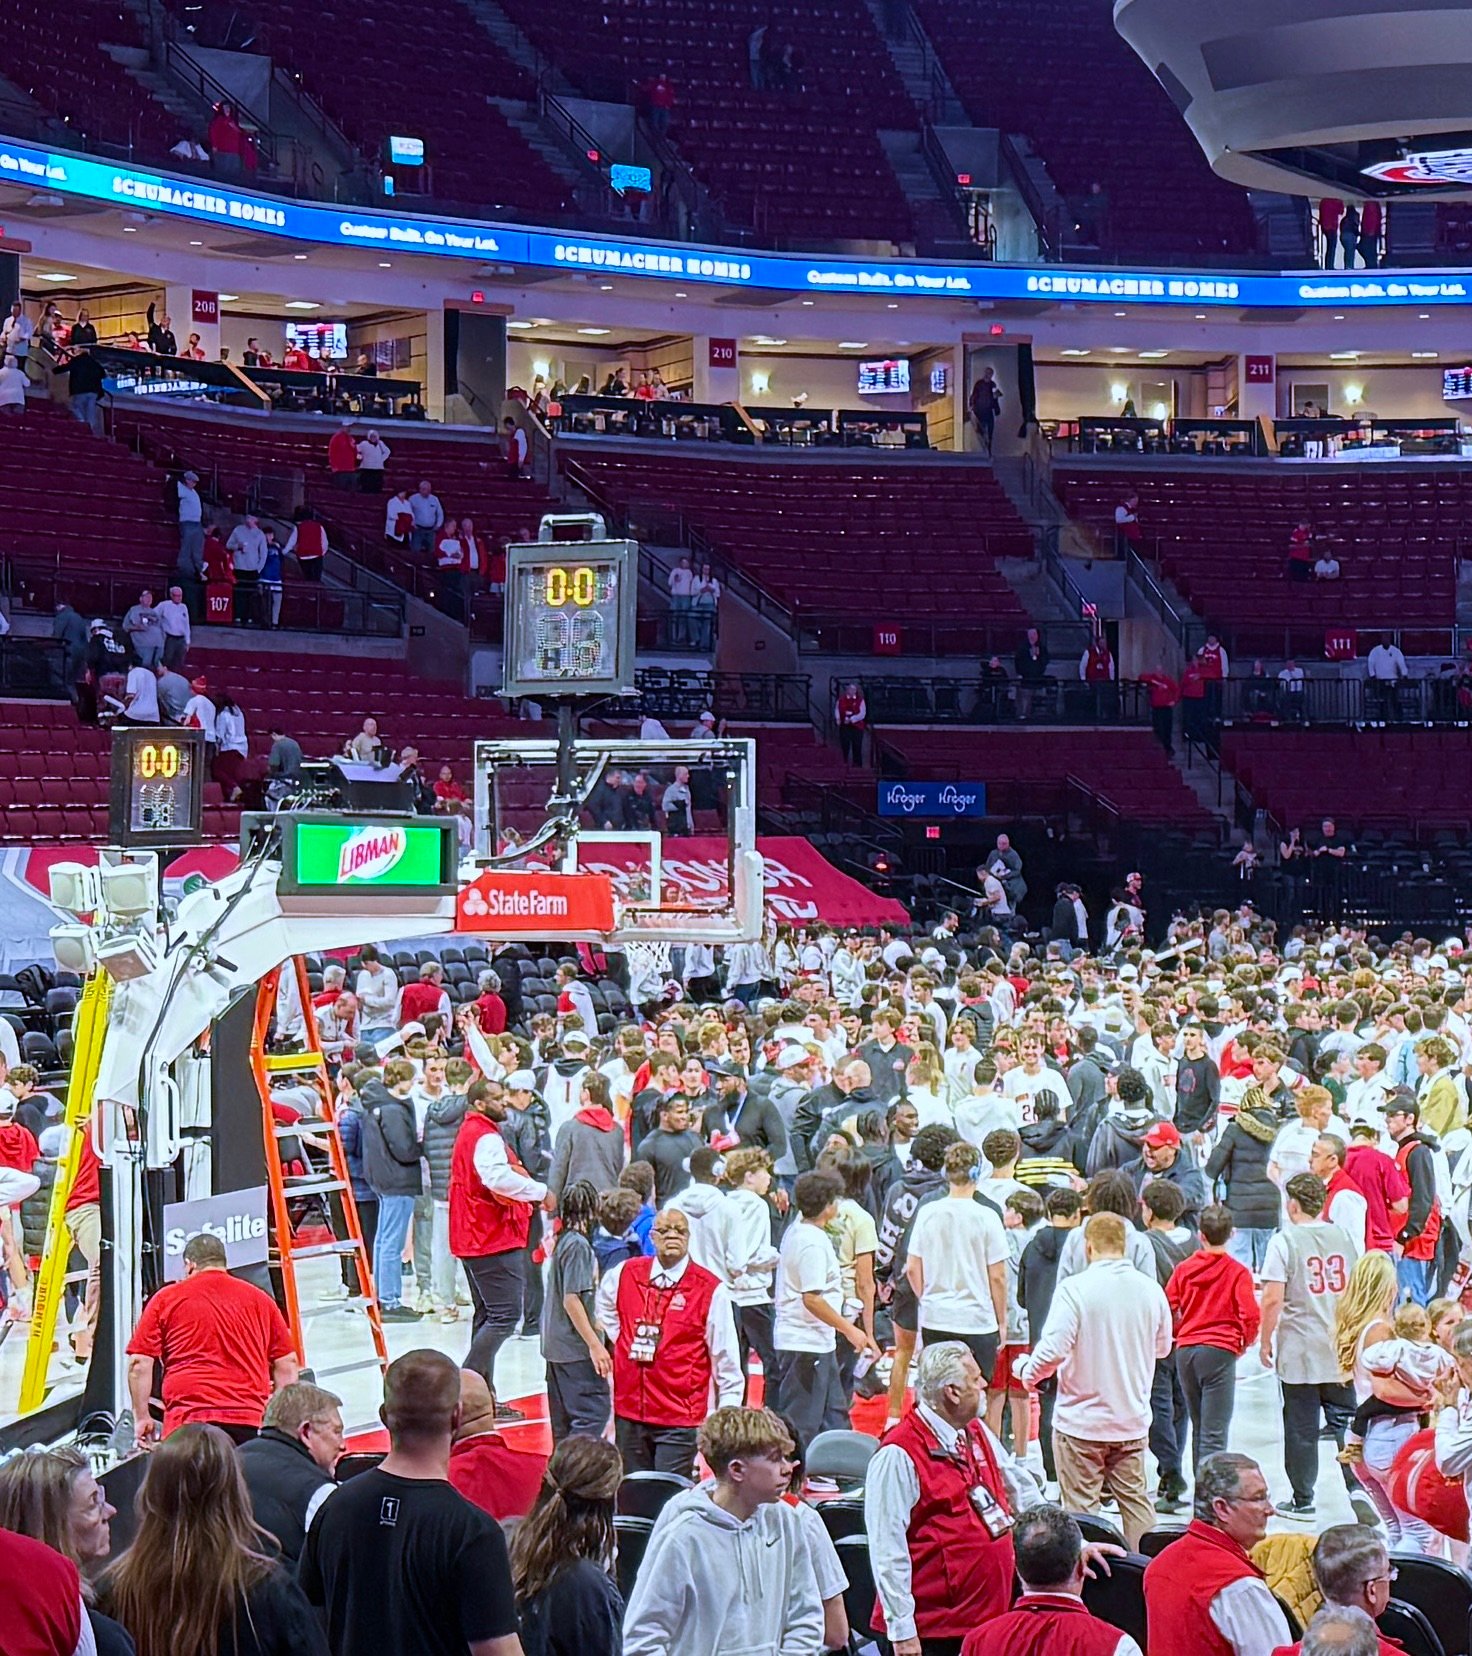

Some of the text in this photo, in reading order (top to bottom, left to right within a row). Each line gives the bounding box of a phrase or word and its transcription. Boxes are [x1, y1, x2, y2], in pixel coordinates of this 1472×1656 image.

[112, 176, 286, 227] SCHUMACHER HOMES
[554, 244, 751, 280] SCHUMACHER HOMES
[1027, 276, 1240, 298] SCHUMACHER HOMES
[712, 346, 733, 359] 210
[1249, 364, 1270, 375] 211
[209, 596, 230, 612] 107
[879, 632, 897, 645] 110
[887, 785, 977, 813] Kroger Kroger
[340, 831, 399, 877] LIBMAN
[1306, 1254, 1346, 1294] 33
